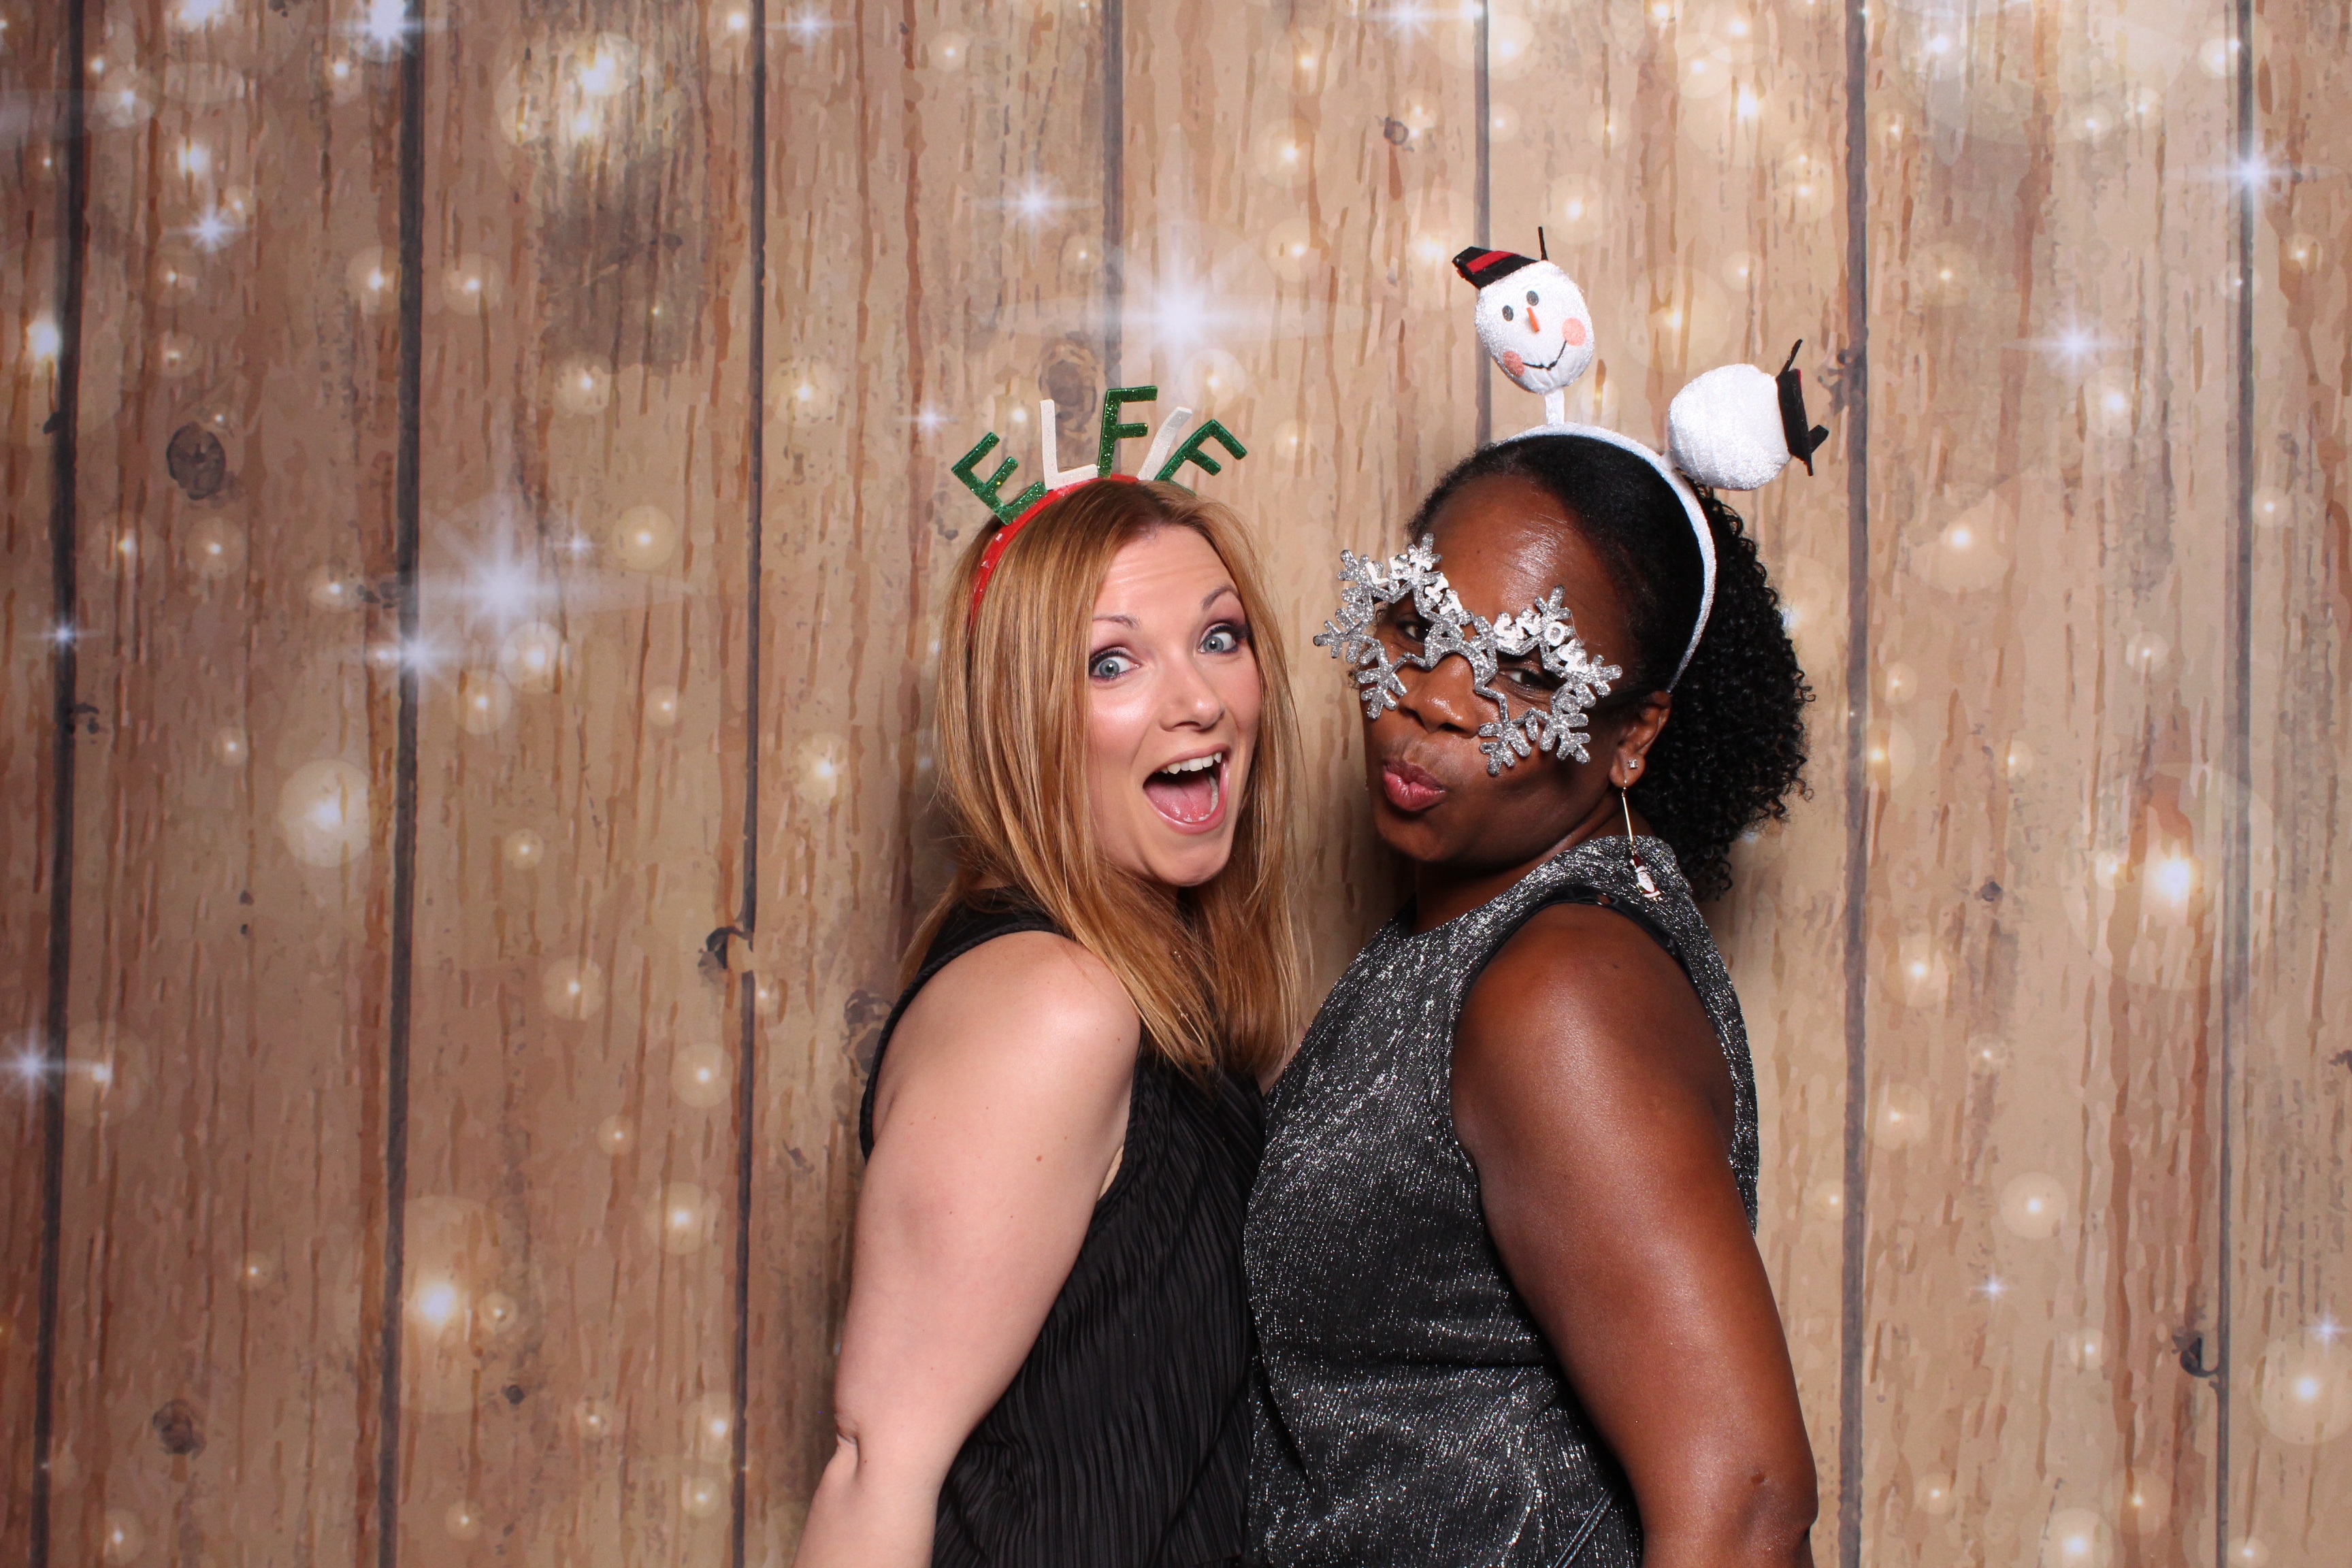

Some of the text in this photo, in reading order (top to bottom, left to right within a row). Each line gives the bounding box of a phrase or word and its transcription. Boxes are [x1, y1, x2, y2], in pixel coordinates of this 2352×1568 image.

[1365, 554, 1589, 674] LET IT SNOW
